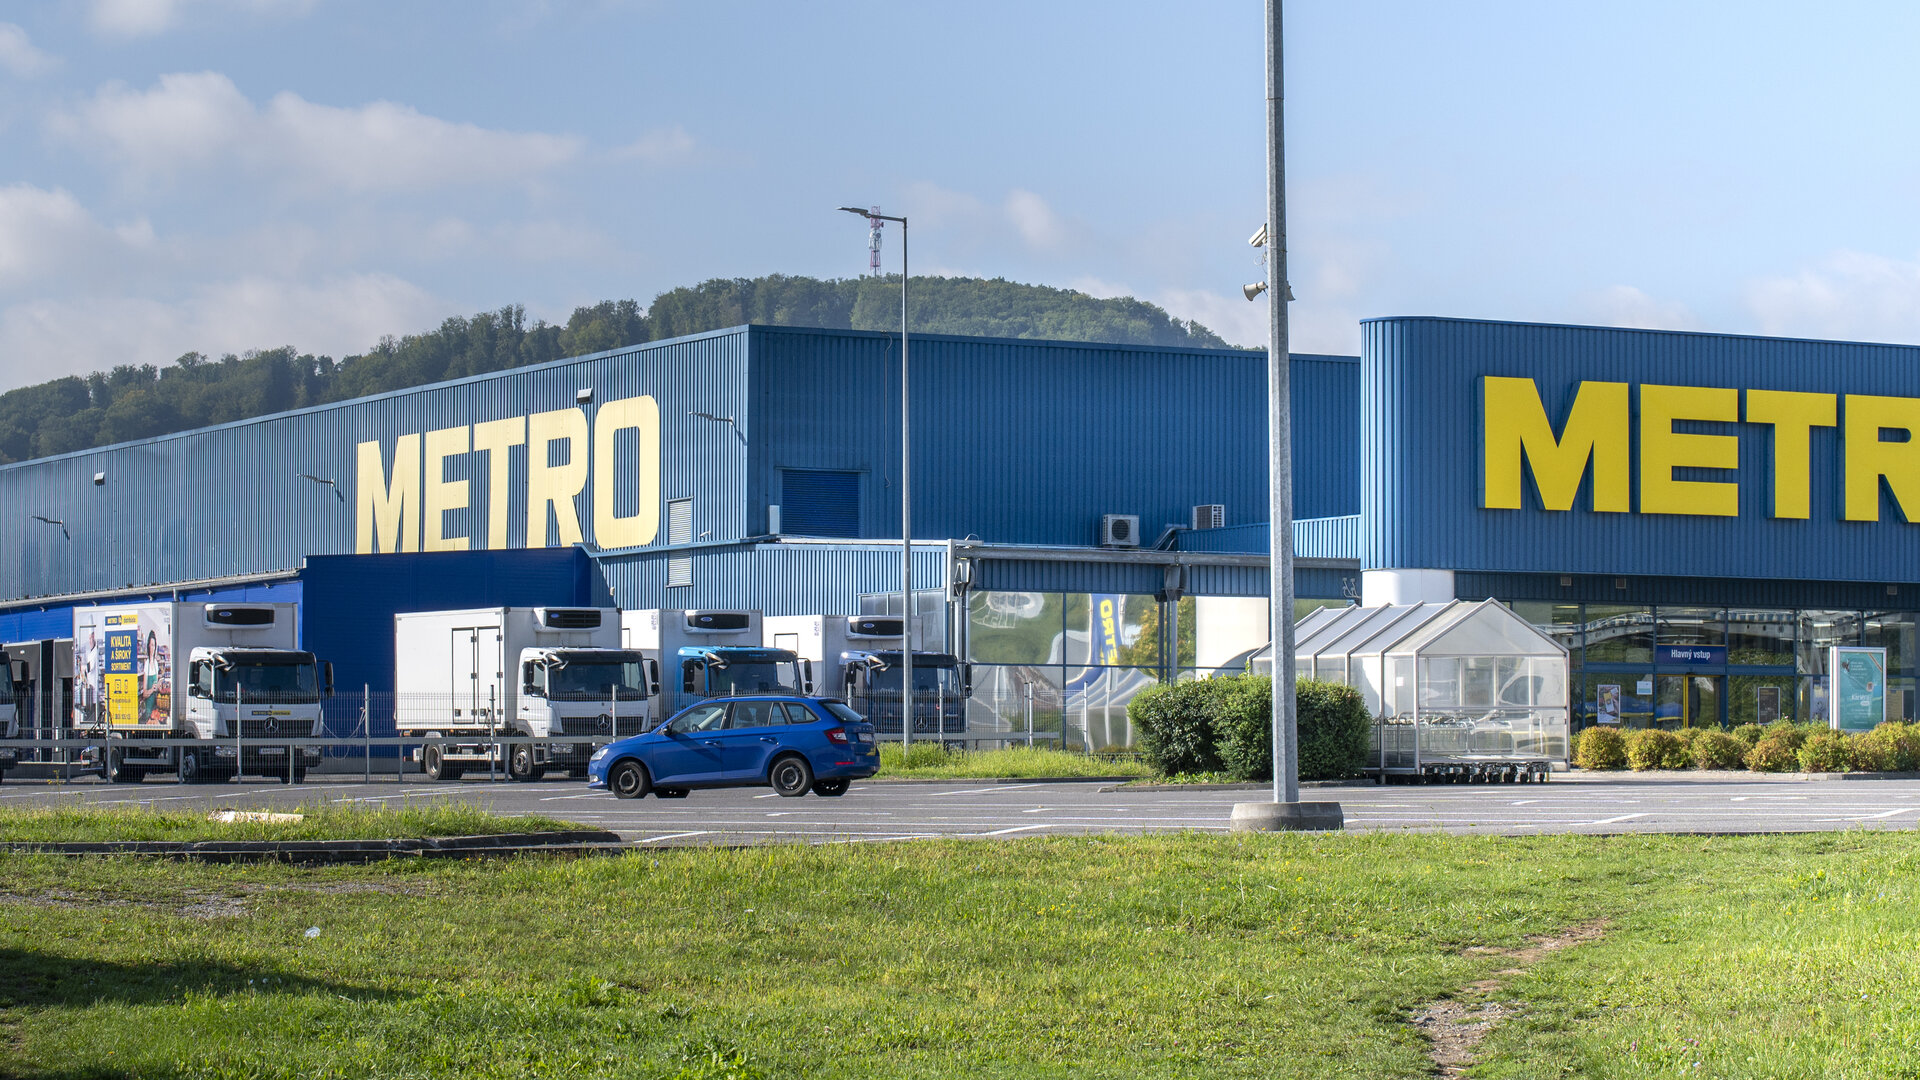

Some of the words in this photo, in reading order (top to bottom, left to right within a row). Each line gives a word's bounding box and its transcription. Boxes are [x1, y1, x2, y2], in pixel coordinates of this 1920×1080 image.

[1483, 376, 1920, 523] METR
[357, 395, 659, 554] METRO
[110, 635, 132, 647] KVALITA
[110, 650, 115, 660] A
[115, 647, 131, 660] ŠIROKÝ
[1671, 649, 1692, 660] Hlavný
[1693, 650, 1711, 661] vstup
[111, 661, 132, 671] SORTIMENT
